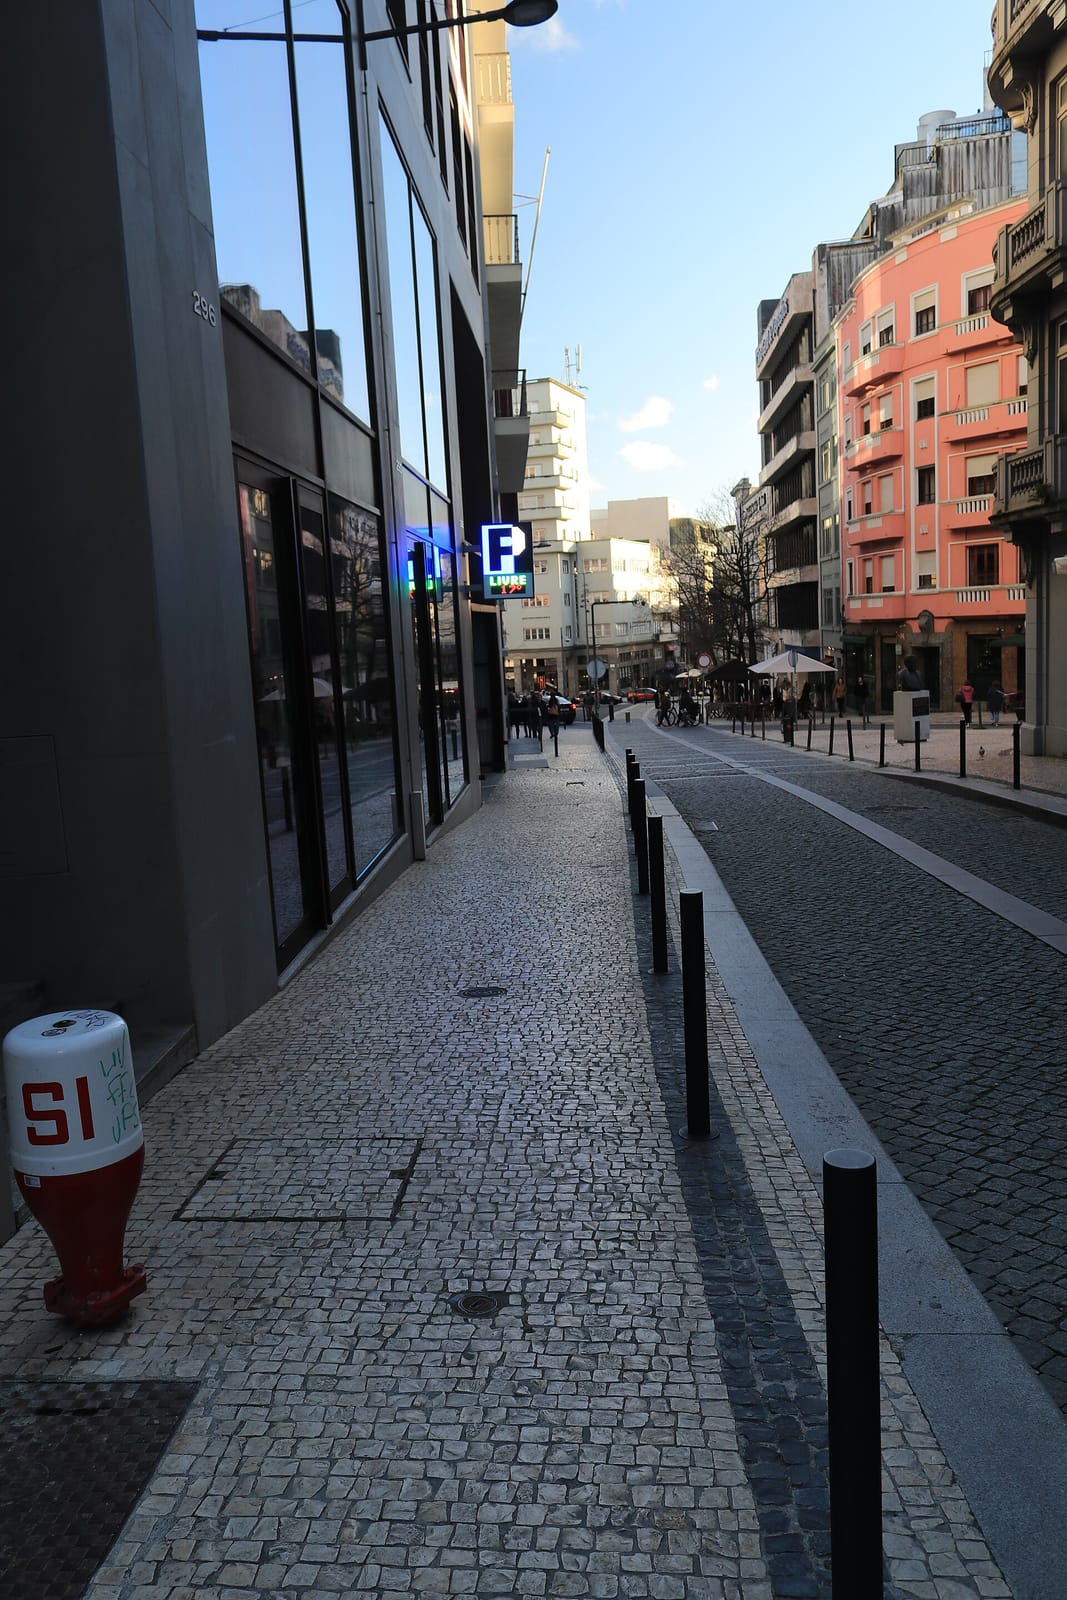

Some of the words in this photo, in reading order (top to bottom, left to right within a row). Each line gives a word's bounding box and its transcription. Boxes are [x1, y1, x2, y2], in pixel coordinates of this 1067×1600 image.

[192, 290, 216, 327] 296
[481, 524, 525, 574] P
[490, 575, 527, 587] LIVRE
[22, 1076, 95, 1146] SI
